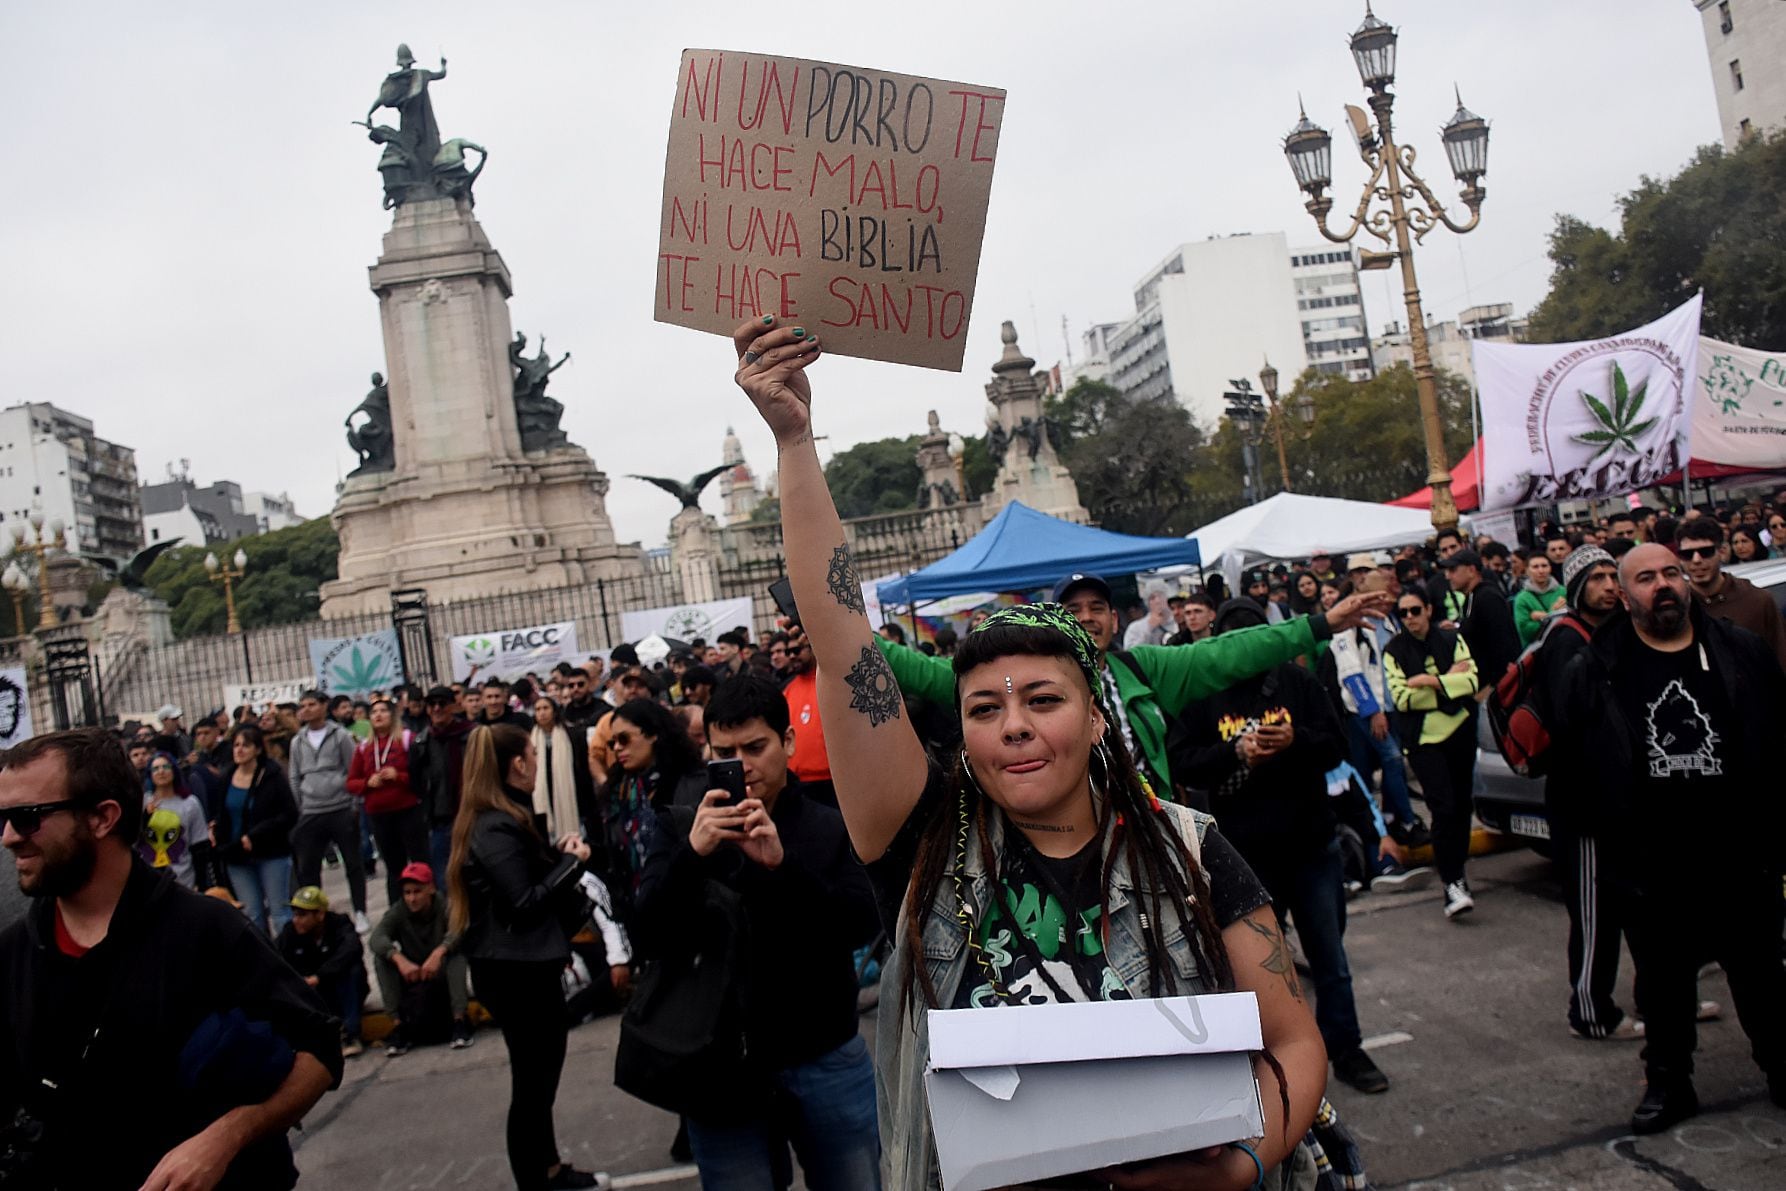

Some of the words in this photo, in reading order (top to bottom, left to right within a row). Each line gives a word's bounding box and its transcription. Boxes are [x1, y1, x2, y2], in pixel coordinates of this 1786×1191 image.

[682, 52, 723, 122] NI
[737, 59, 800, 135] UN
[804, 66, 934, 155] PORRO
[948, 90, 1005, 163] TE
[698, 133, 796, 192] HACE
[808, 150, 944, 224] MALO,
[670, 193, 708, 245] NI
[726, 204, 801, 259] UNA
[660, 253, 700, 312] TE
[715, 263, 801, 320] HACE
[819, 276, 965, 340] SANTO
[501, 628, 559, 652] FACC
